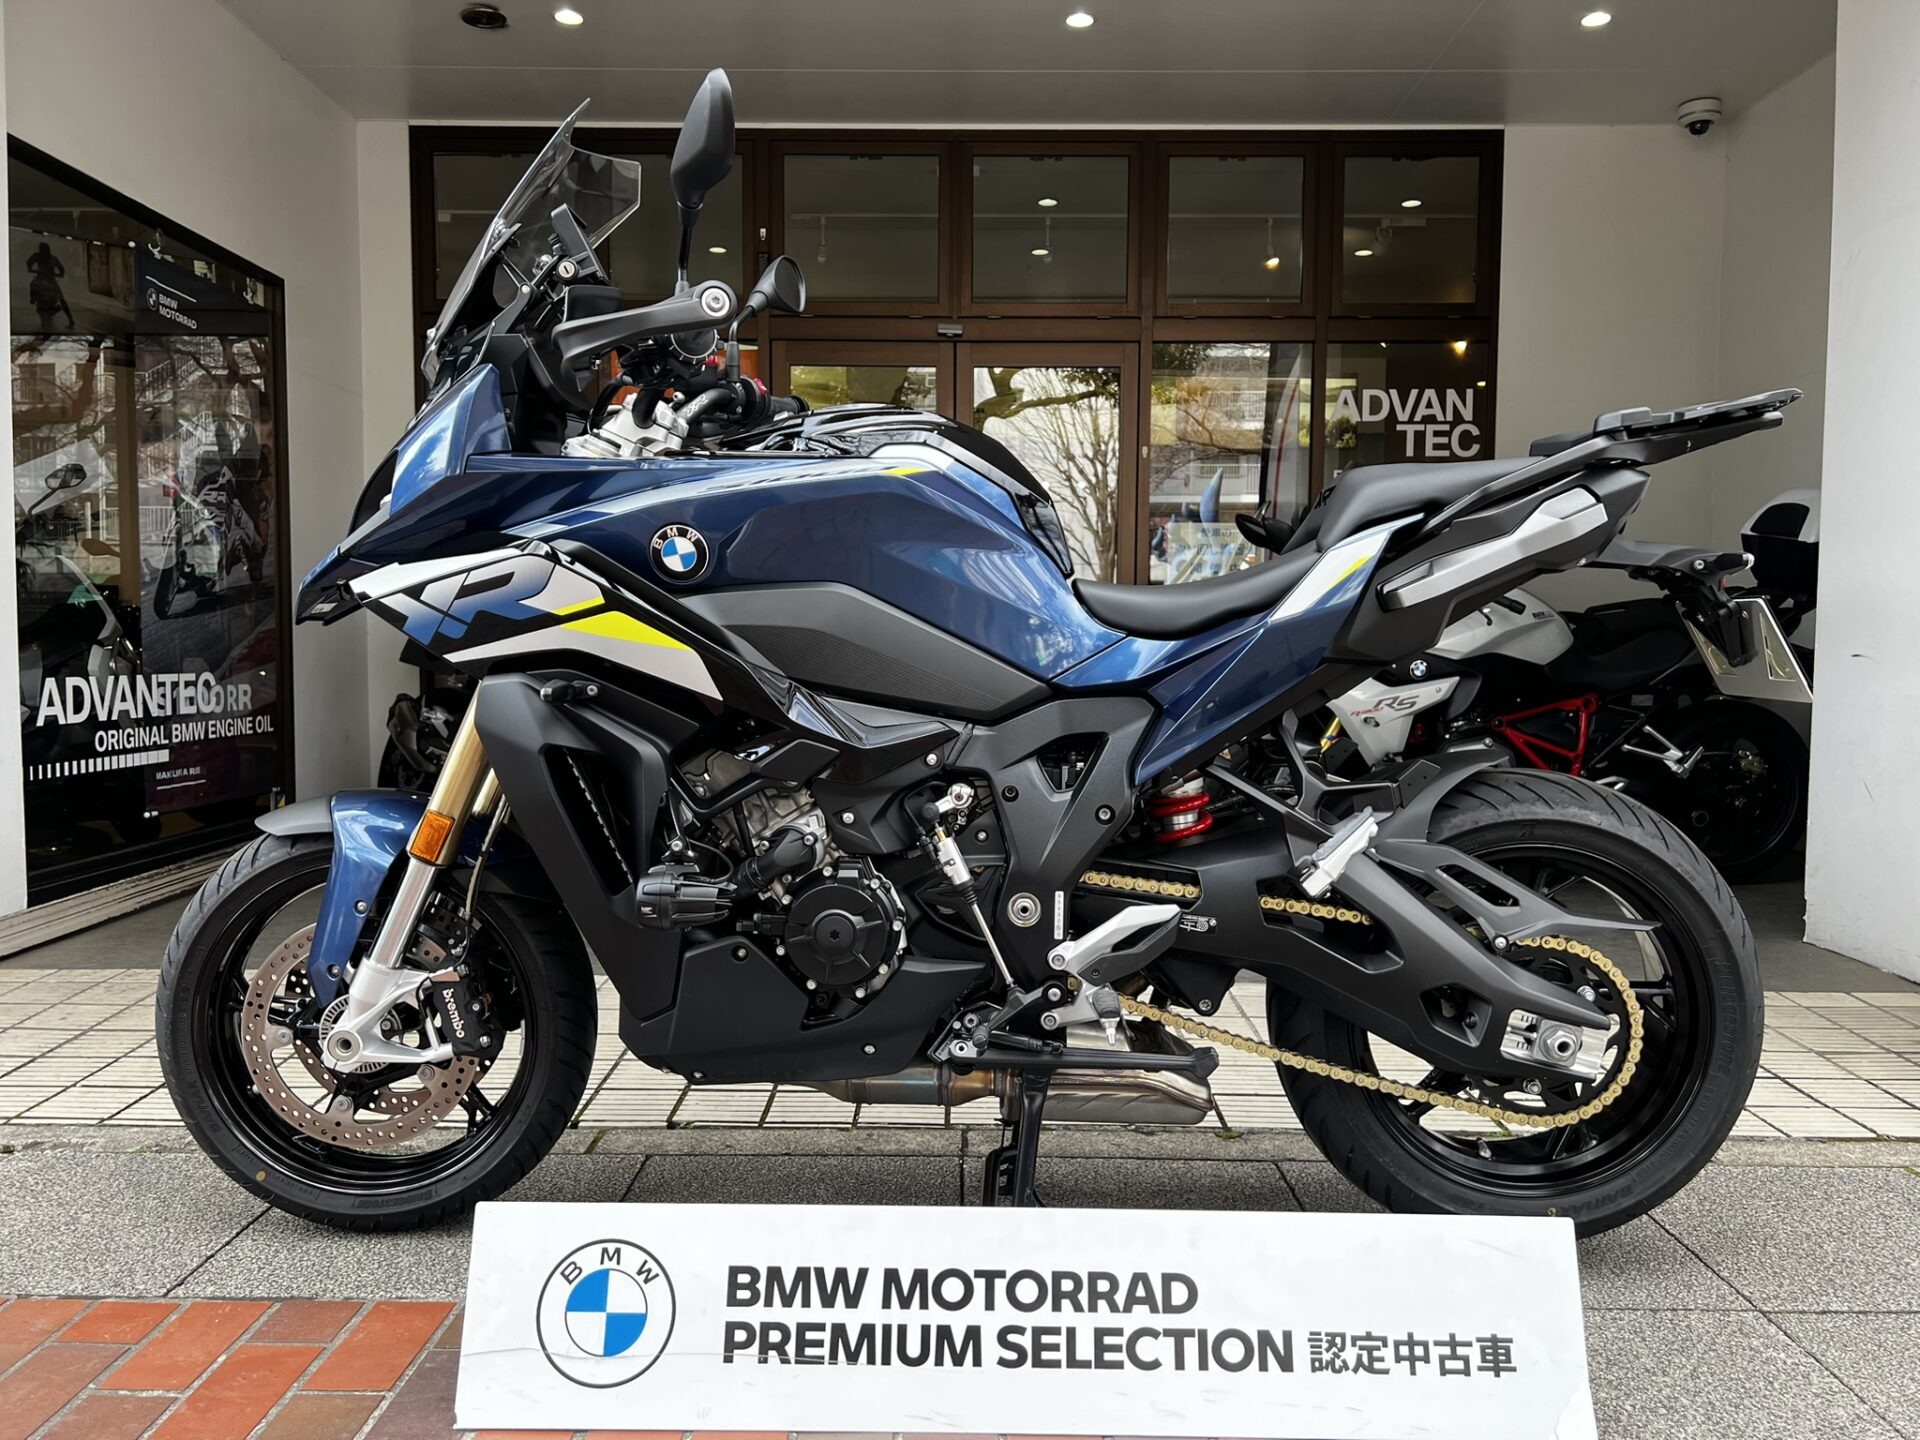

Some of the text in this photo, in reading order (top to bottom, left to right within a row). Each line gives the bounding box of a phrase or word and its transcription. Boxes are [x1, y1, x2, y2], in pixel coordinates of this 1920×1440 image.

[158, 293, 178, 309] BMW
[159, 305, 198, 329] MOTORRAD
[1331, 388, 1474, 422] ADVAN
[1396, 423, 1481, 458] TEC
[653, 527, 699, 550] BMW
[36, 672, 217, 727] ADVANTEC
[1373, 695, 1420, 712] RS
[95, 715, 274, 752] ORIGINAL BMW ENGINE OIL
[442, 987, 465, 1039] brembo
[560, 1247, 660, 1285] BMW
[726, 1265, 1198, 1314] BMW MOTORRAD
[723, 1321, 1517, 1378] PREMIUM SELECTION 認定中古車
